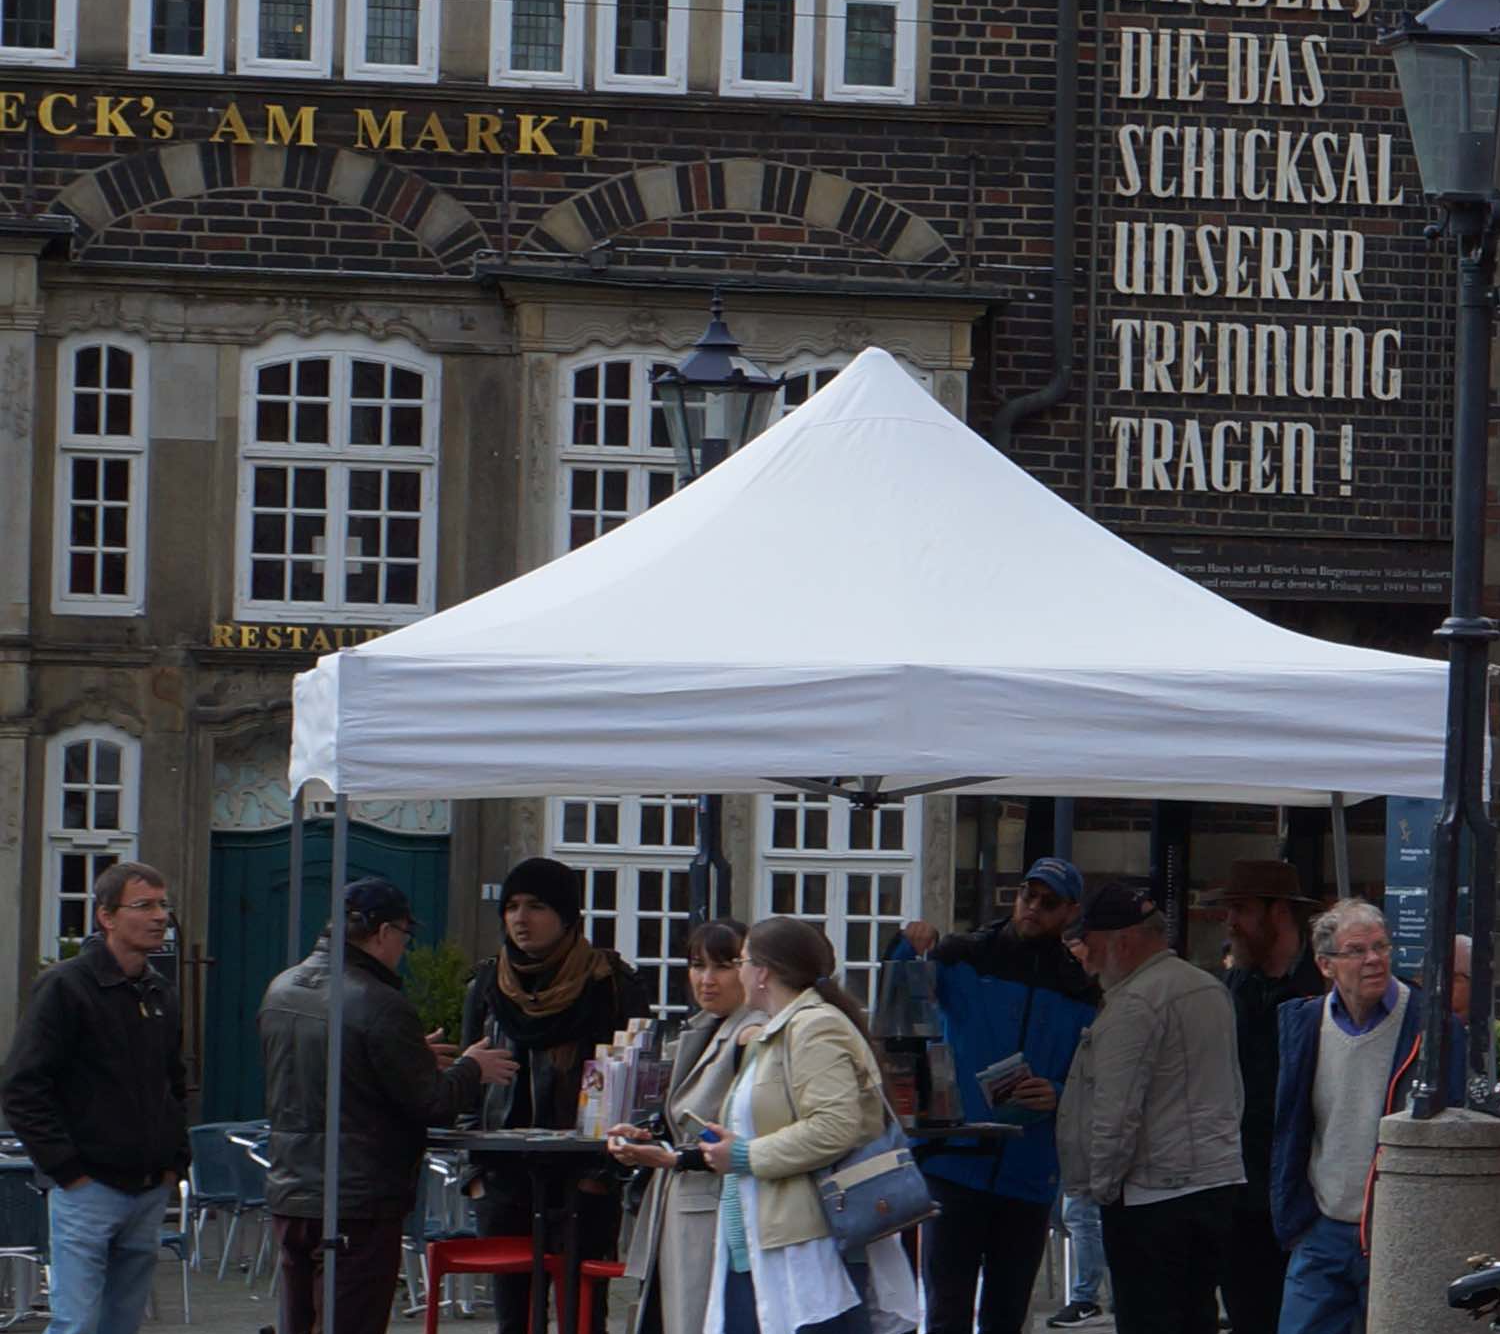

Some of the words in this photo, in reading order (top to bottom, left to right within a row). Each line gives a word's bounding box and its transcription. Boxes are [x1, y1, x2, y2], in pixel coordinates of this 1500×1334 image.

[1118, 25, 1206, 104] DIE
[1227, 31, 1327, 109] DAS
[208, 101, 319, 147] AM
[353, 107, 609, 158] MARKT
[1113, 123, 1403, 207] SCHICKSAL
[1113, 221, 1366, 304] UNSERER
[1110, 316, 1402, 402] TRENNUNG
